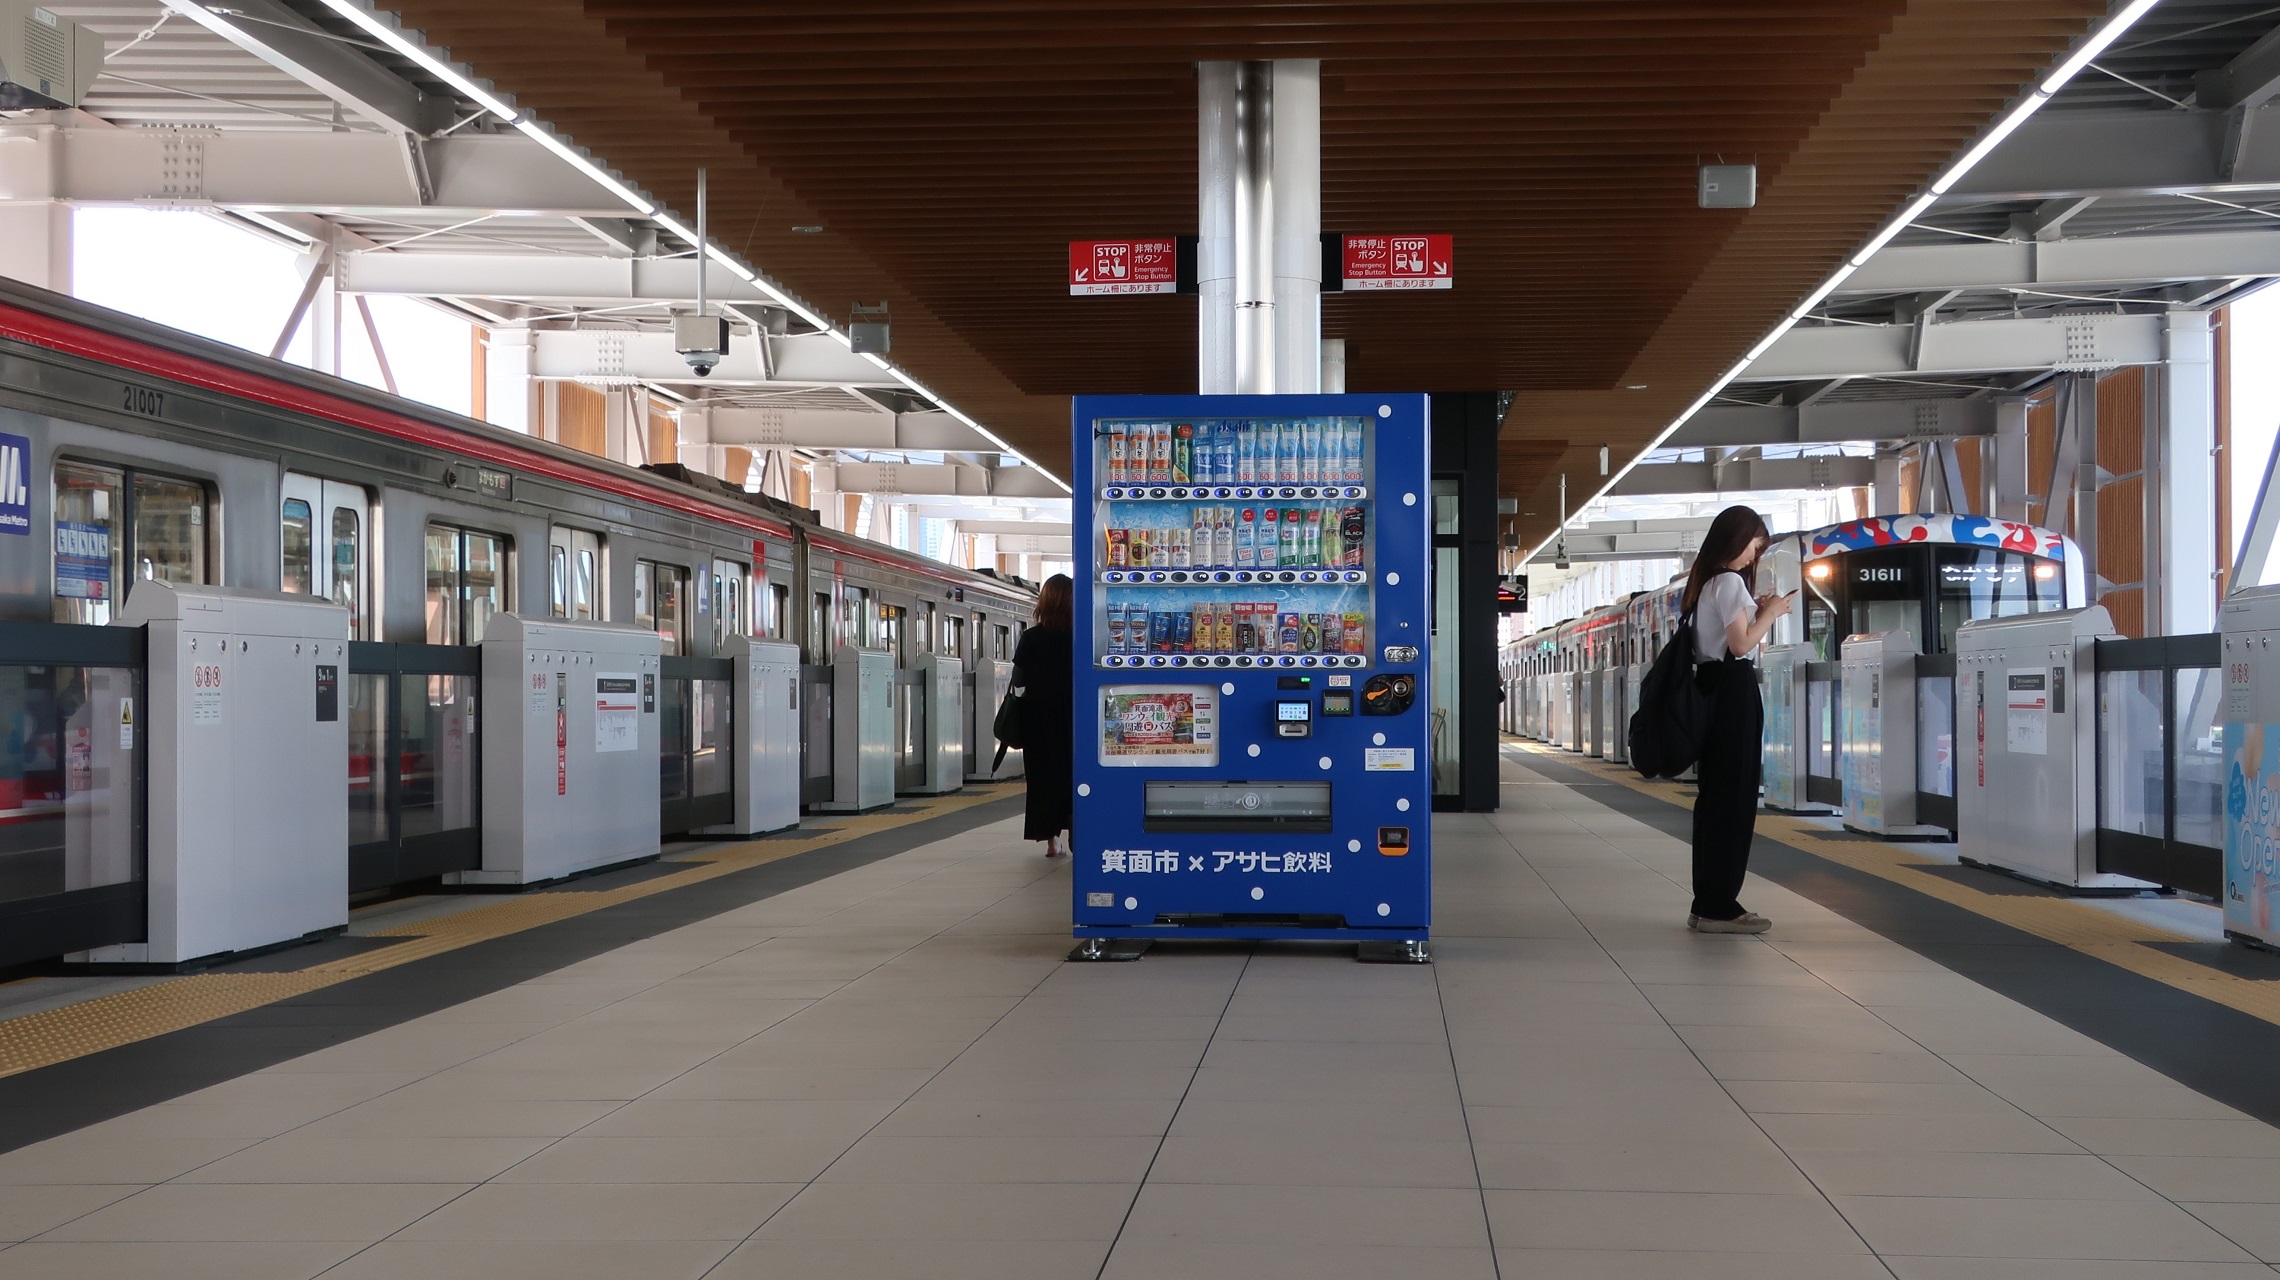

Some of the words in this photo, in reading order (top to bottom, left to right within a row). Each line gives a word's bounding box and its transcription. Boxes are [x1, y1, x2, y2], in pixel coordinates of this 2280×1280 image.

[1134, 243, 1172, 253] 非常停止
[1348, 239, 1386, 249] 非常停止
[1394, 241, 1425, 251] STOP
[1097, 247, 1127, 257] STOP
[1358, 250, 1386, 259] ボタン
[1134, 254, 1162, 264] ボタン
[1086, 284, 1161, 293] ホーム柵にあります
[1359, 279, 1435, 288] ホーム柵にあります
[124, 386, 163, 417] 21007
[11, 515, 28, 527] Metro
[1859, 568, 1901, 582] 31611
[1518, 587, 1526, 601] 2
[1101, 849, 1180, 874] 箕面市
[1212, 851, 1332, 873] アサヒ飲料
